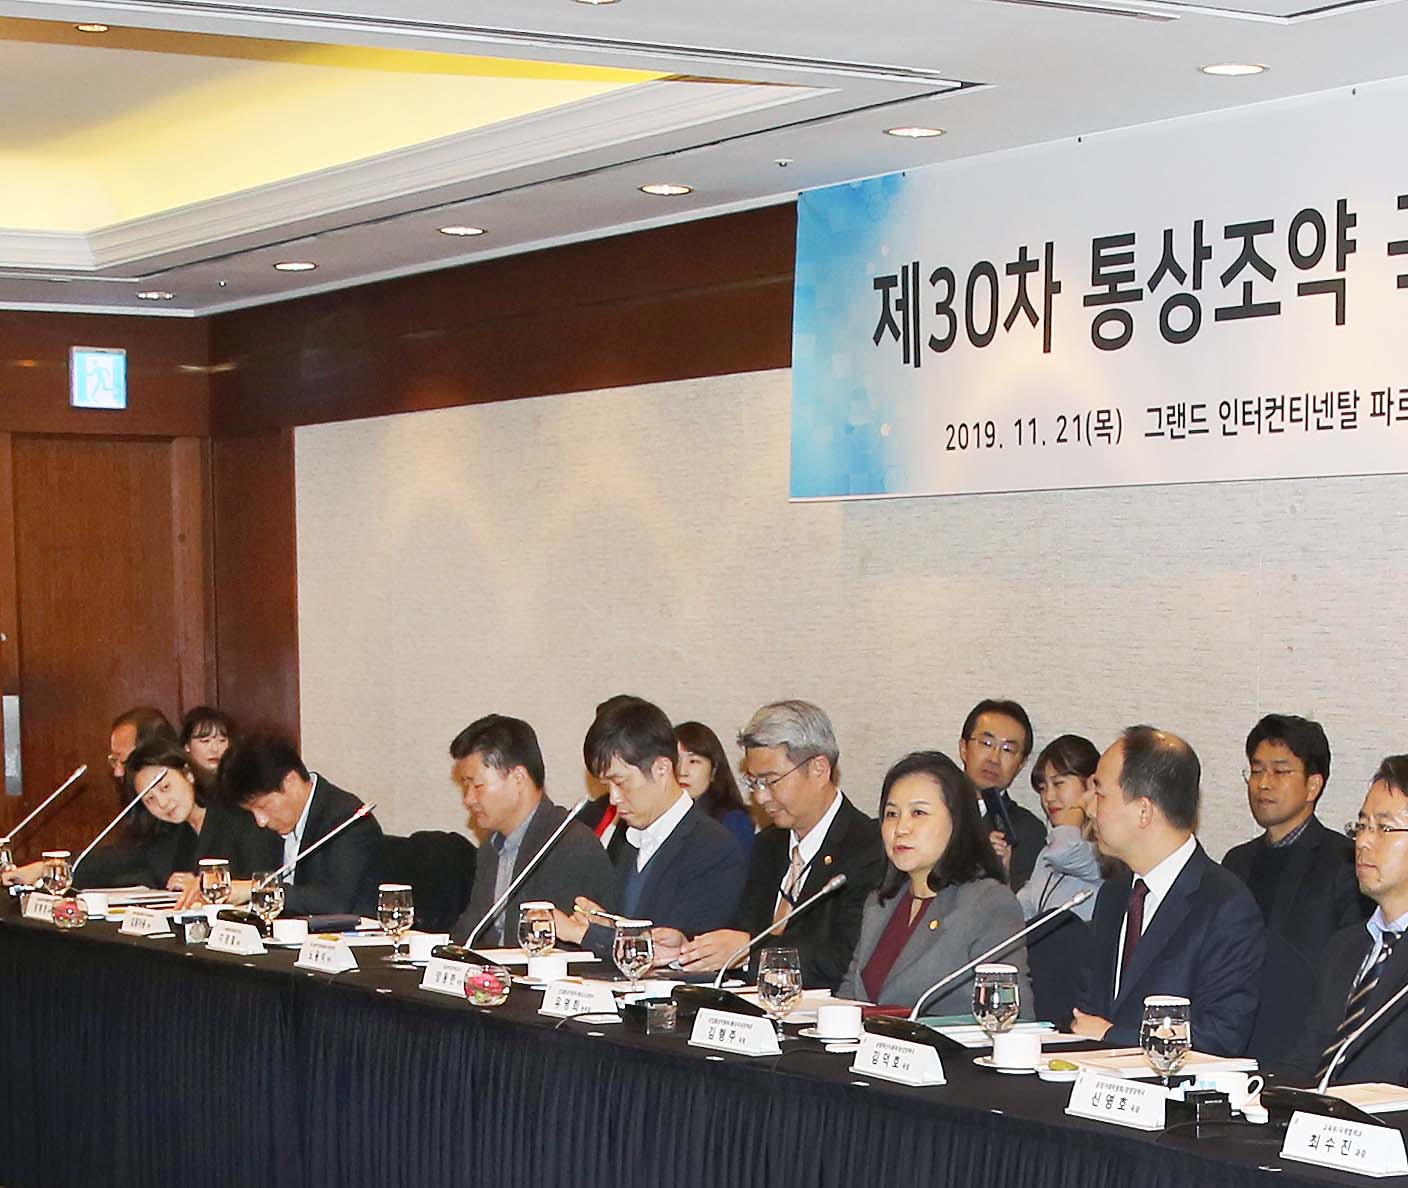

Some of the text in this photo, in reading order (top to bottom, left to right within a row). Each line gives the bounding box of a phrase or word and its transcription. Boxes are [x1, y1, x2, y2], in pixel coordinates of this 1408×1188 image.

[872, 241, 1062, 369] 제30차
[1082, 197, 1358, 351] 통상조약
[945, 420, 1004, 451] 2019.
[1013, 416, 1047, 446] 11.
[1055, 407, 1123, 447] 21(목)
[1143, 401, 1210, 440] 그랜드
[1218, 389, 1360, 436] 인터컨티넨탈
[1092, 1091, 1128, 1110] 신영호
[1308, 1134, 1353, 1156] 최수진
